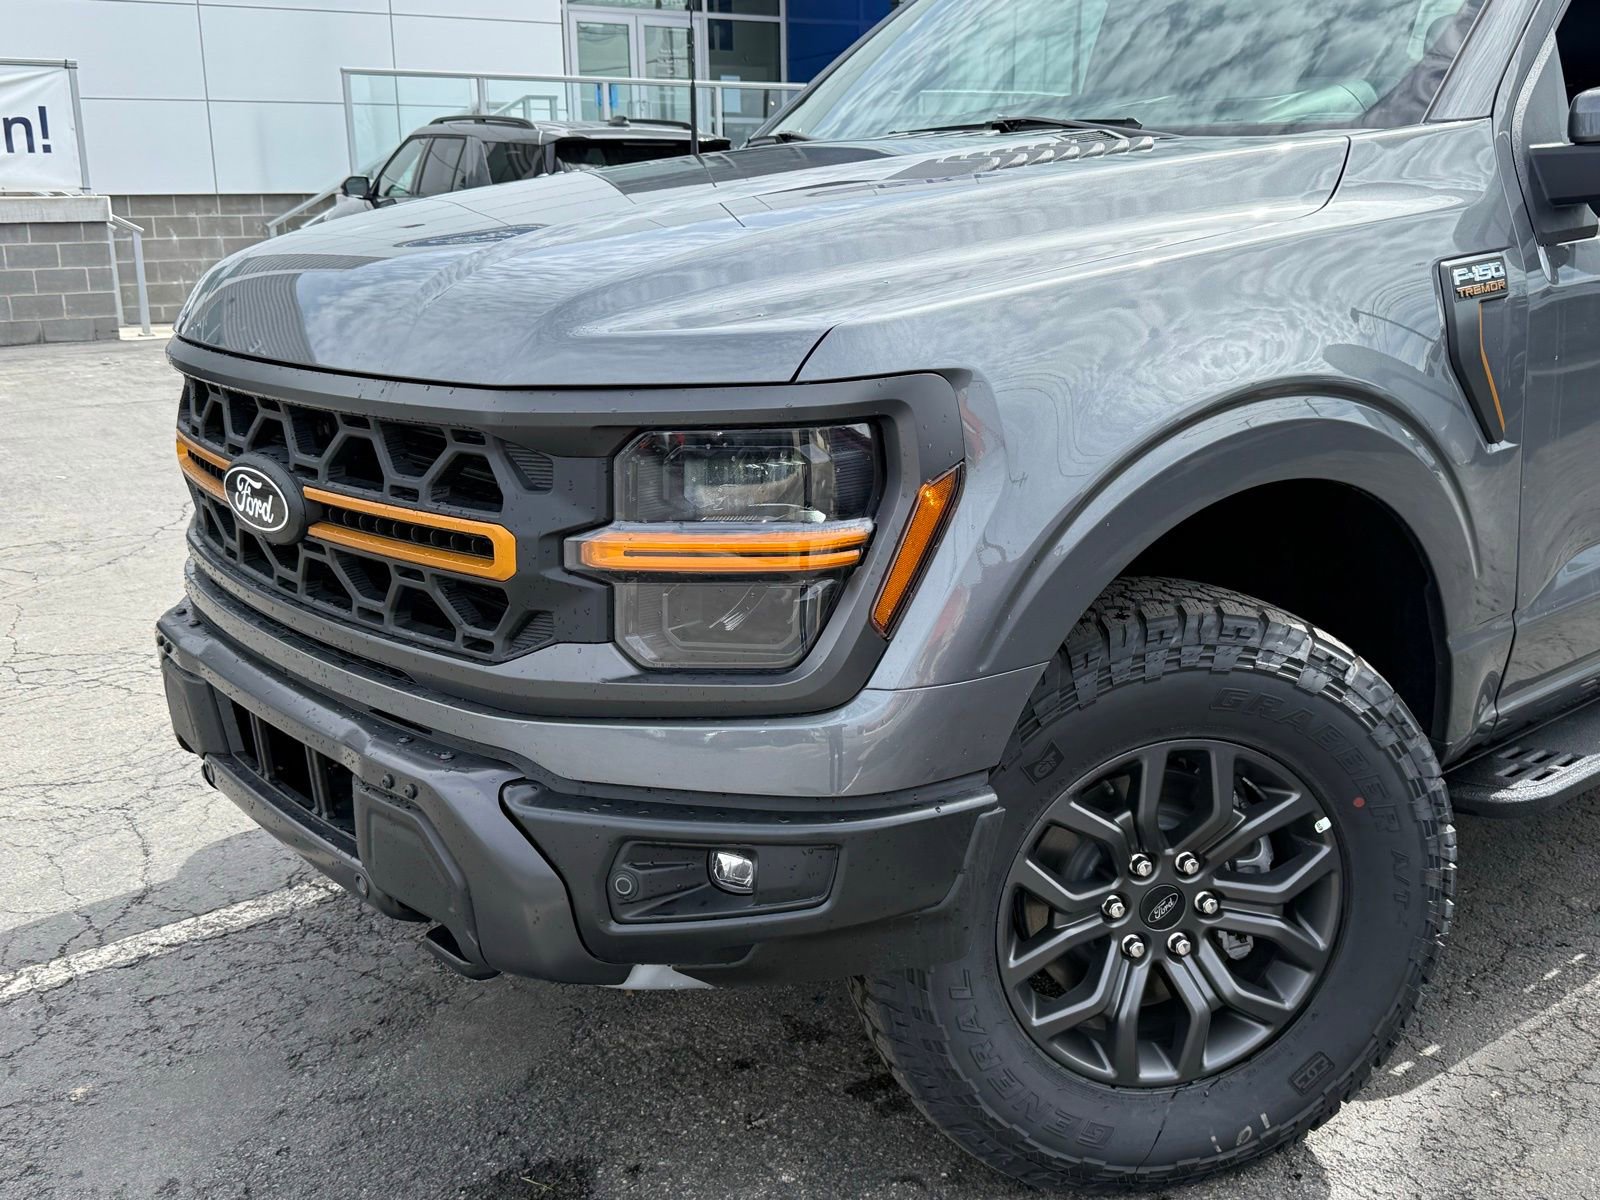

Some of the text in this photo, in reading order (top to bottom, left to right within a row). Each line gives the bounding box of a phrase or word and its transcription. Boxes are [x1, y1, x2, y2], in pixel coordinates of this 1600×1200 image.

[1453, 261, 1506, 286] F-150
[1456, 279, 1506, 298] TREMOR
[235, 473, 274, 524] Ford
[1209, 687, 1401, 832] GRABBER
[1154, 897, 1175, 919] Ford
[949, 968, 1116, 1150] GENERAL
